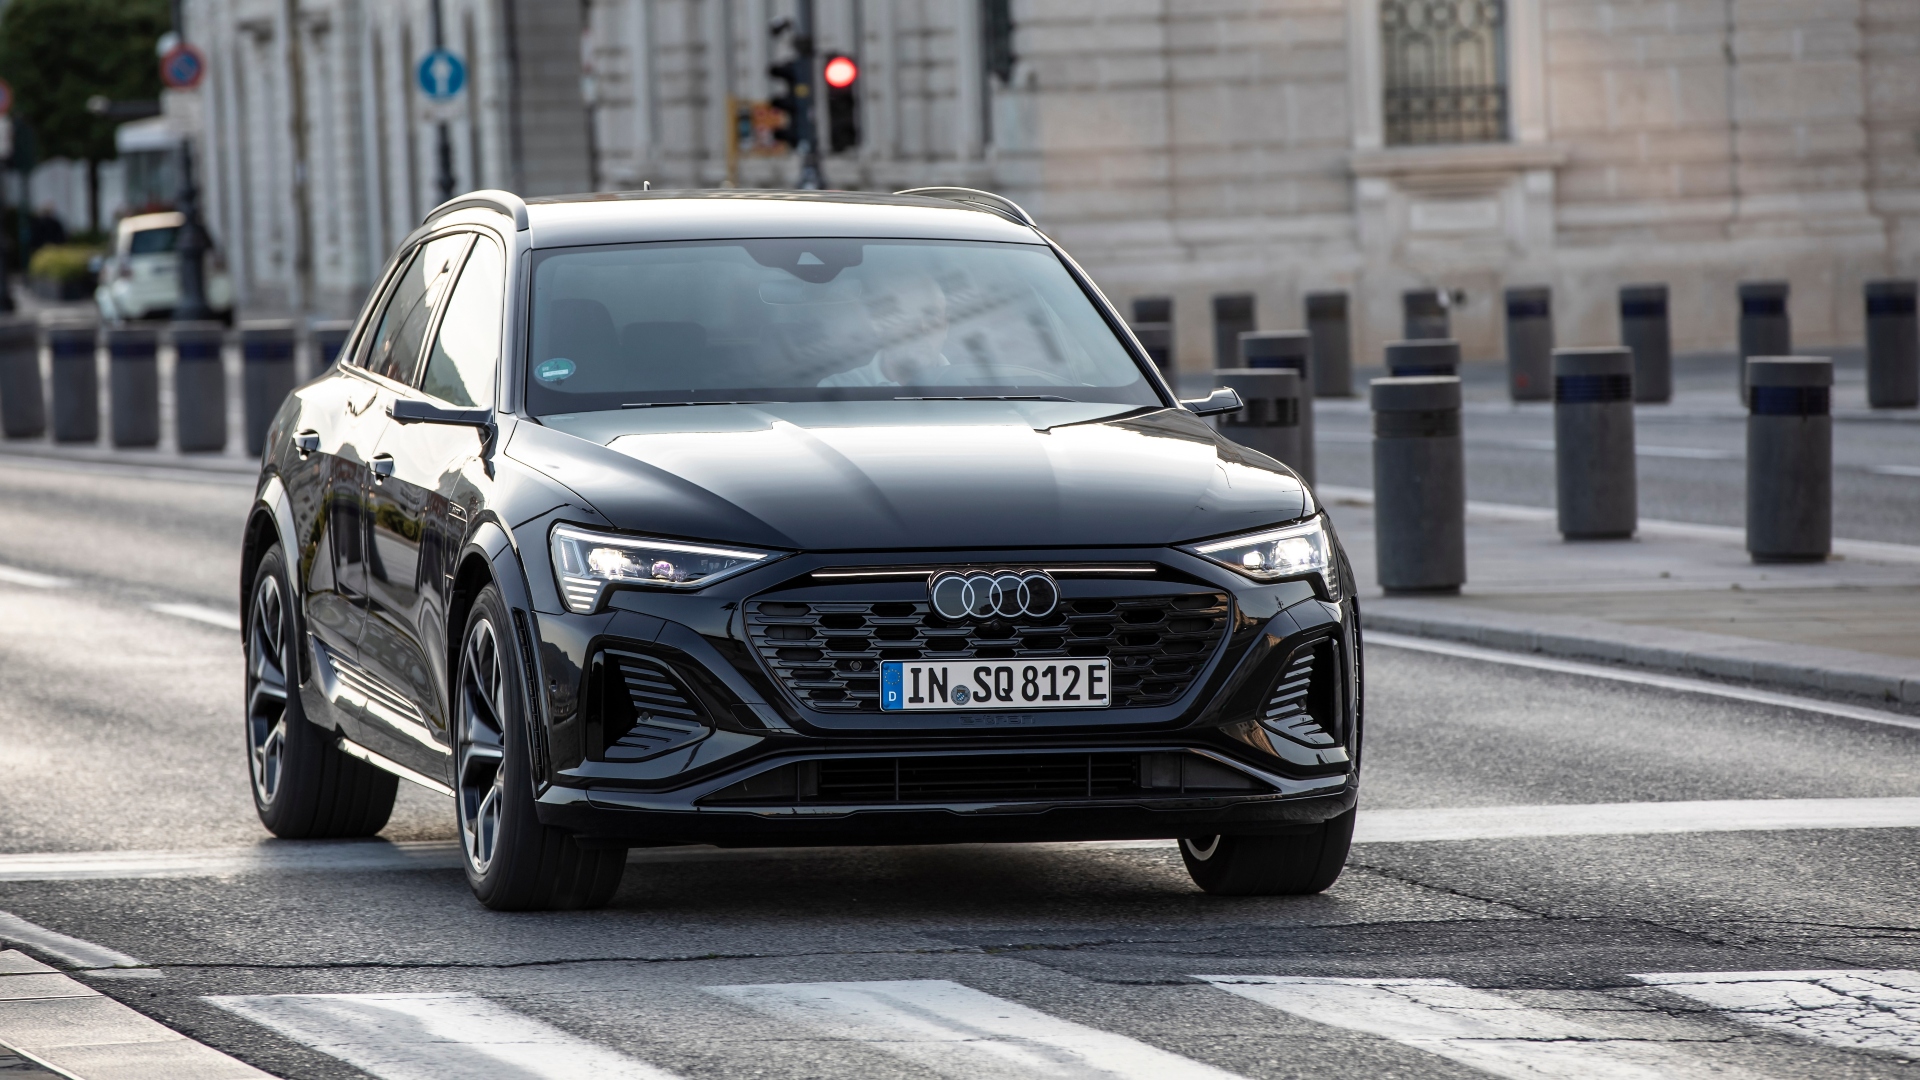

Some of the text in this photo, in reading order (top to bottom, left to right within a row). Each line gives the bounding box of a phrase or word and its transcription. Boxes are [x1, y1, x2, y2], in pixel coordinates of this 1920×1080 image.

[888, 691, 897, 702] D
[908, 667, 948, 703] IN
[972, 666, 1014, 703] SQ
